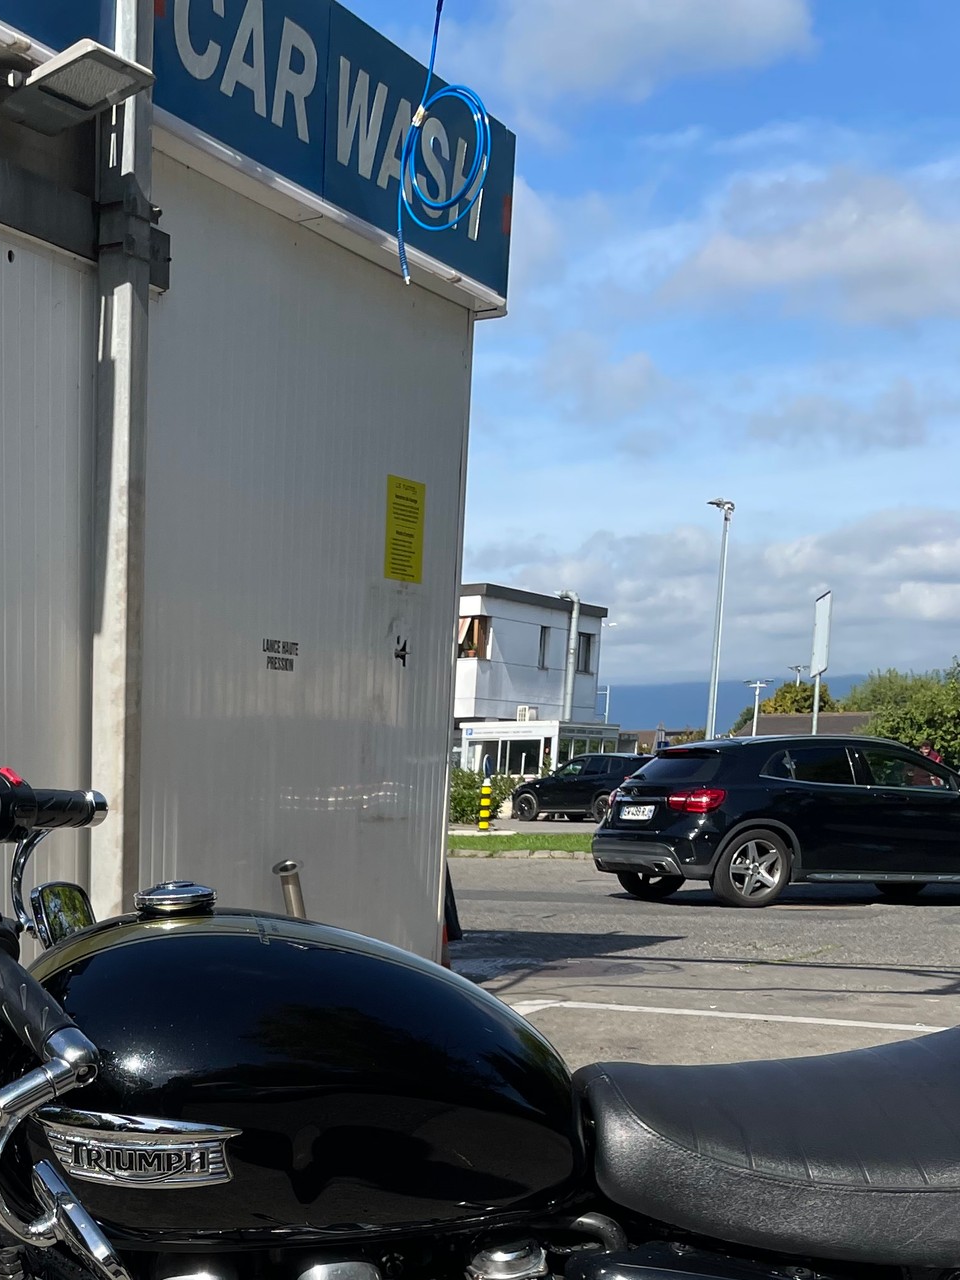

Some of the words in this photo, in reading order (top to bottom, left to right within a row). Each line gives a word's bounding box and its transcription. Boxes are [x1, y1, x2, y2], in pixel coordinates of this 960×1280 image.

[174, 0, 318, 144] CAR
[336, 56, 487, 241] WASH
[266, 656, 294, 671] PRESSION
[66, 1141, 208, 1177] TRIUMPH
